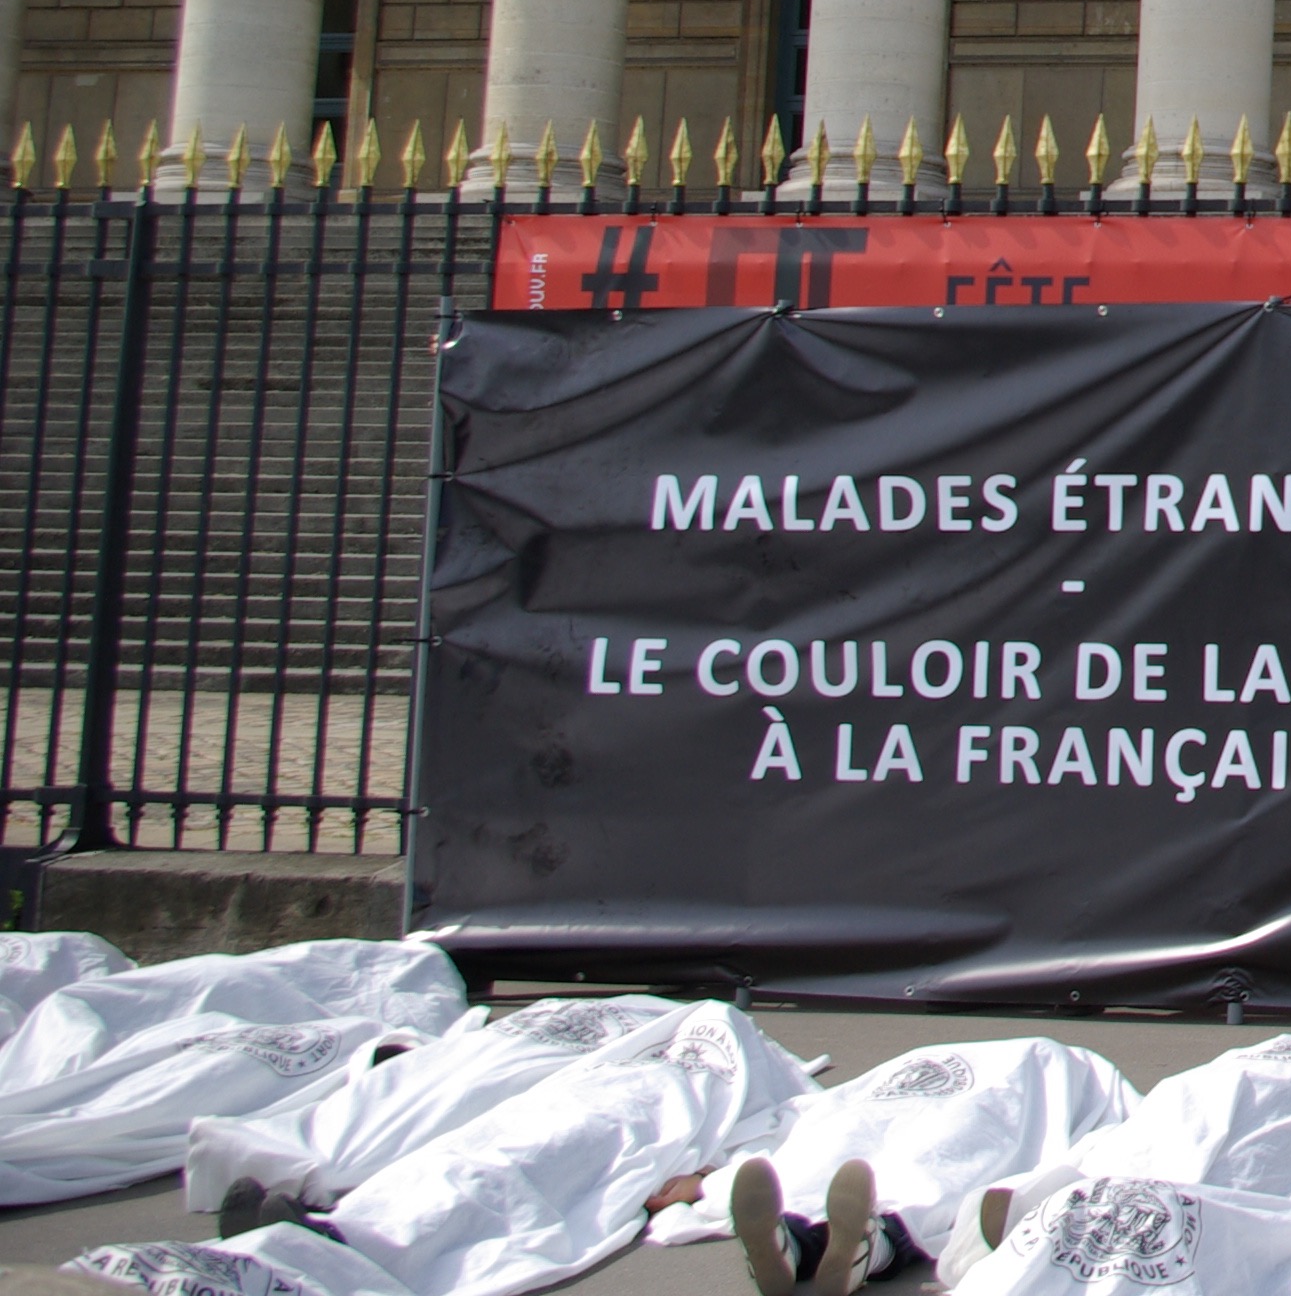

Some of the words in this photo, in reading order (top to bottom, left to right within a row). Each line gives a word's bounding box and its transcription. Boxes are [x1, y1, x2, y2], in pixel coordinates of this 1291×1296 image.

[652, 474, 1018, 532] MALADES
[589, 638, 668, 695] LE
[697, 639, 1042, 699] COULOIR
[1075, 642, 1168, 701] DE
[1204, 644, 1291, 703] LA
[751, 707, 802, 780] À
[836, 724, 923, 782] LA
